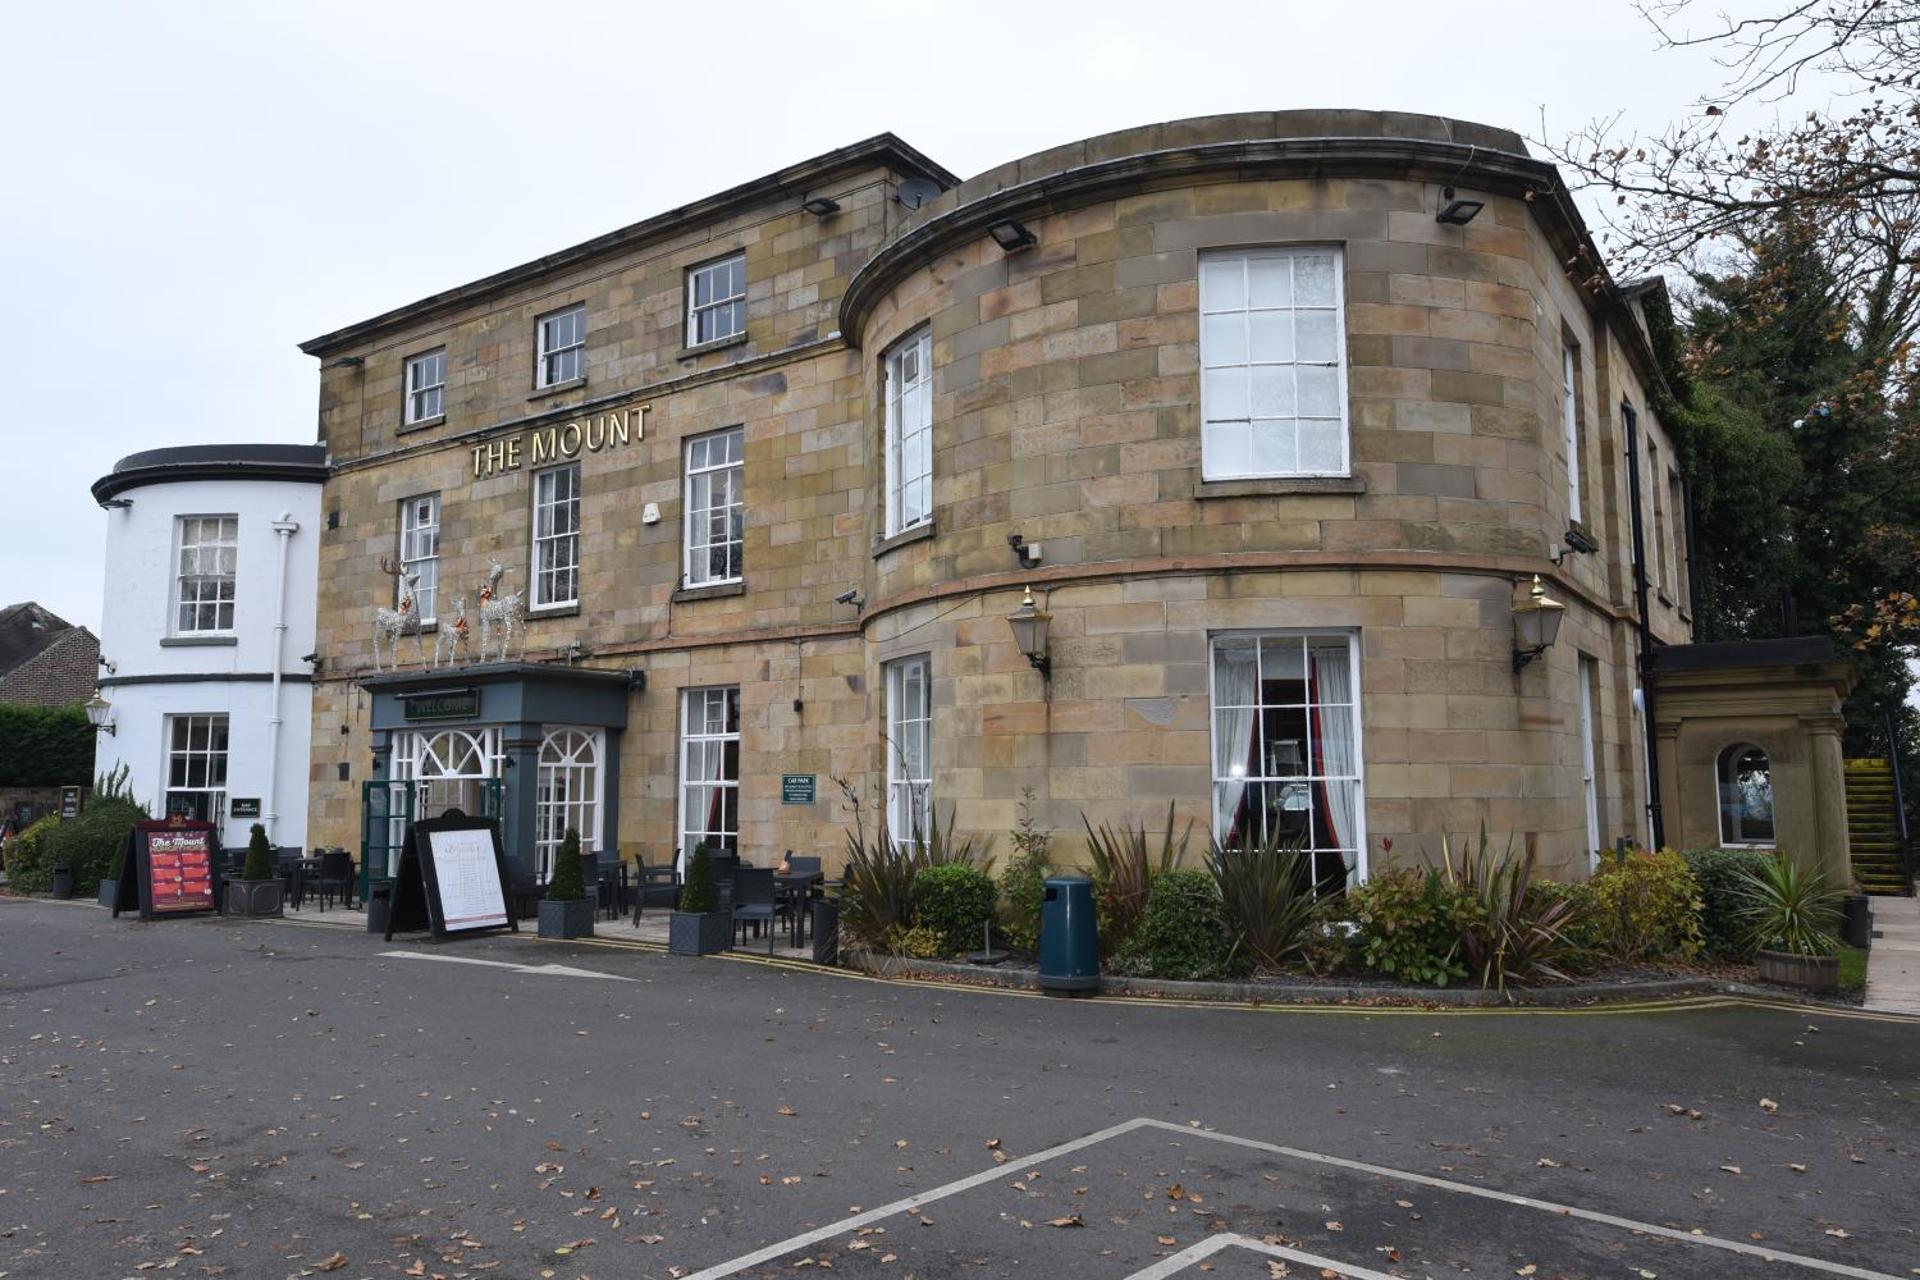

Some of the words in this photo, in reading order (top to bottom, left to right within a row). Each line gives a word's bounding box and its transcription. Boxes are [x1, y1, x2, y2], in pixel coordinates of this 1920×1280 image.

[471, 436, 521, 477] THE
[531, 404, 652, 465] MOUNT
[152, 837, 171, 848] The
[172, 836, 206, 847] Mount
